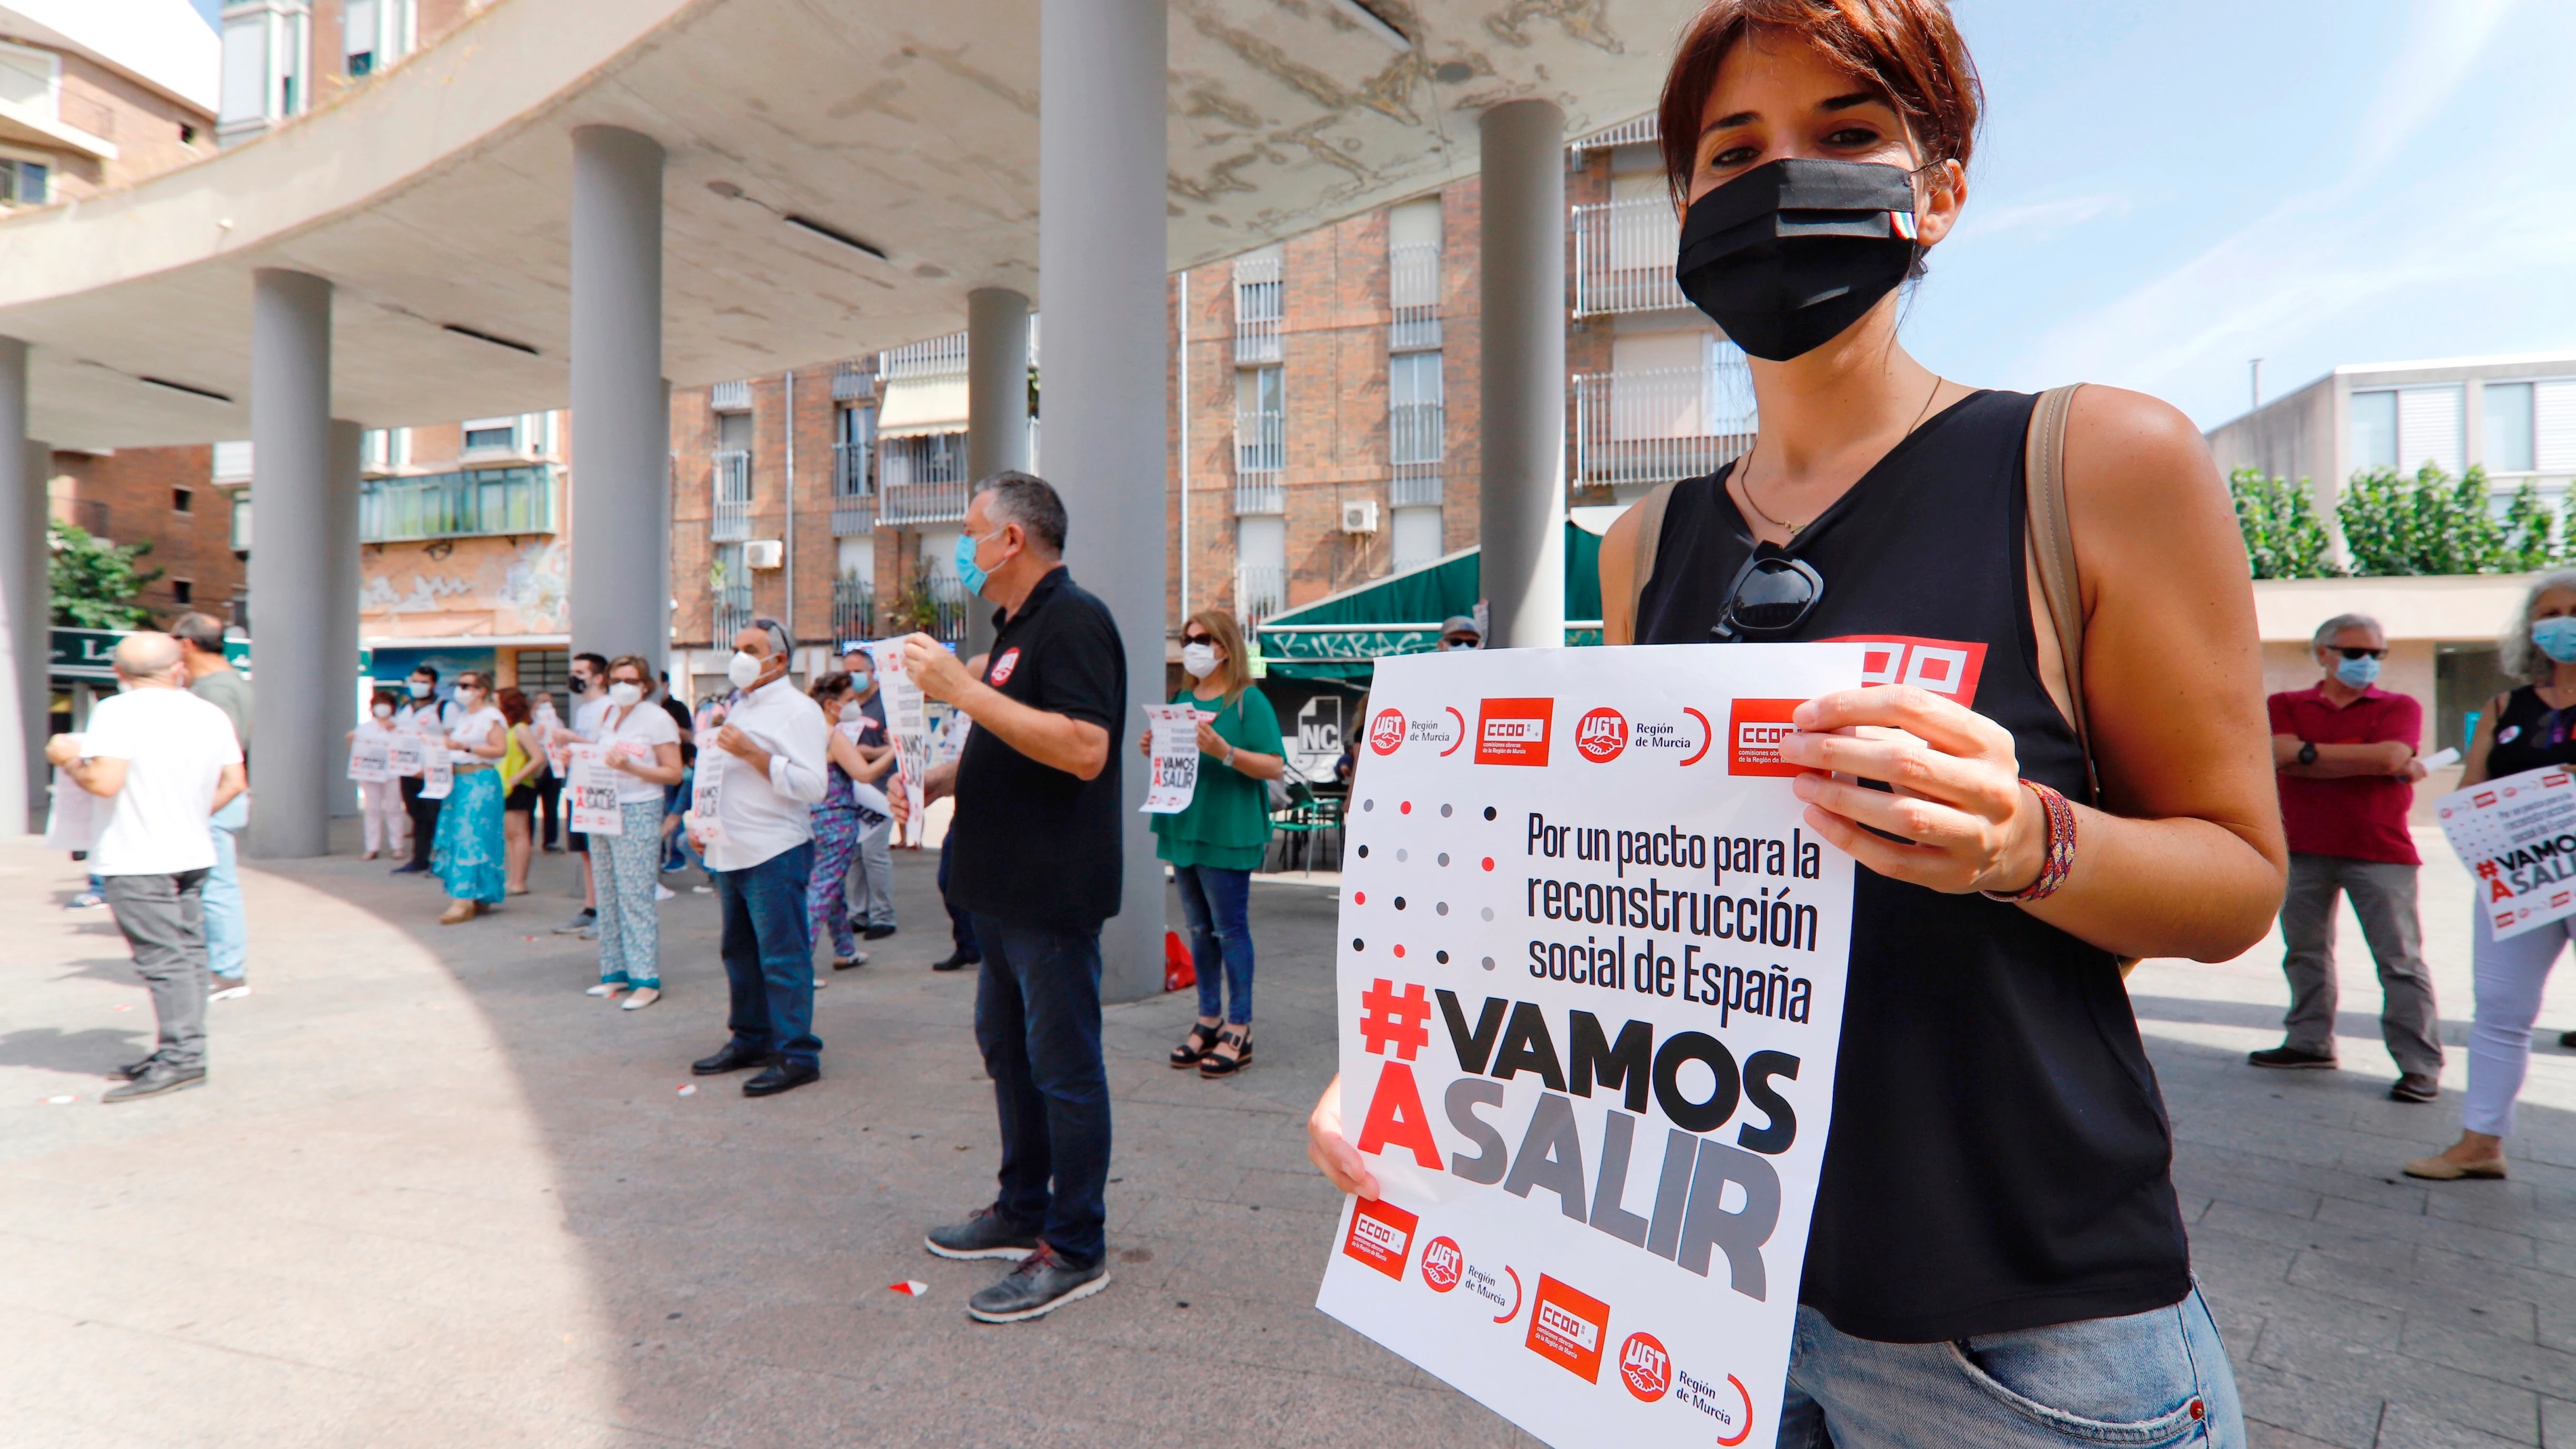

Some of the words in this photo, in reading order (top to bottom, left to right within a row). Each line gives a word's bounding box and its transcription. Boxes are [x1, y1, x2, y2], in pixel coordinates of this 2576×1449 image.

[1301, 723, 1339, 750] NC
[1375, 716, 1402, 734] UGT
[1410, 732, 1419, 741] de
[1421, 732, 1450, 742] Murcia
[1412, 720, 1438, 731] Región
[1488, 723, 1525, 737] CCOO
[1583, 716, 1622, 739] UGT
[1637, 723, 1674, 736] Región
[1635, 737, 1648, 748] de
[1652, 737, 1691, 748] Murcia
[1153, 770, 1161, 787] A
[1163, 771, 1194, 789] SALIR
[1528, 812, 1570, 859] Por
[1577, 828, 1610, 862] un
[1617, 824, 1706, 878] pacto
[1714, 836, 1786, 886] para
[1793, 828, 1820, 880] la
[2491, 877, 2515, 903] A
[1528, 878, 1818, 952] reconstrucción
[1529, 936, 1625, 990] social
[1634, 939, 1675, 998] de
[1684, 944, 1813, 1028] España
[1359, 977, 1800, 1155] #VAMOS
[1357, 1060, 1444, 1171] A
[1444, 1077, 1781, 1302] SALIR
[1359, 1219, 1391, 1243] CCOO
[1429, 1240, 1461, 1273] UGT
[1469, 1265, 1496, 1287] Región
[1465, 1280, 1476, 1291] de
[1477, 1286, 1505, 1307] Murcia
[1543, 1306, 1580, 1338] CCOO
[1564, 1346, 1577, 1359] Murcia
[1627, 1338, 1666, 1380] UGT
[1679, 1370, 1716, 1399] Región
[1676, 1388, 1689, 1403] de
[1693, 1394, 1732, 1425] Murcia
